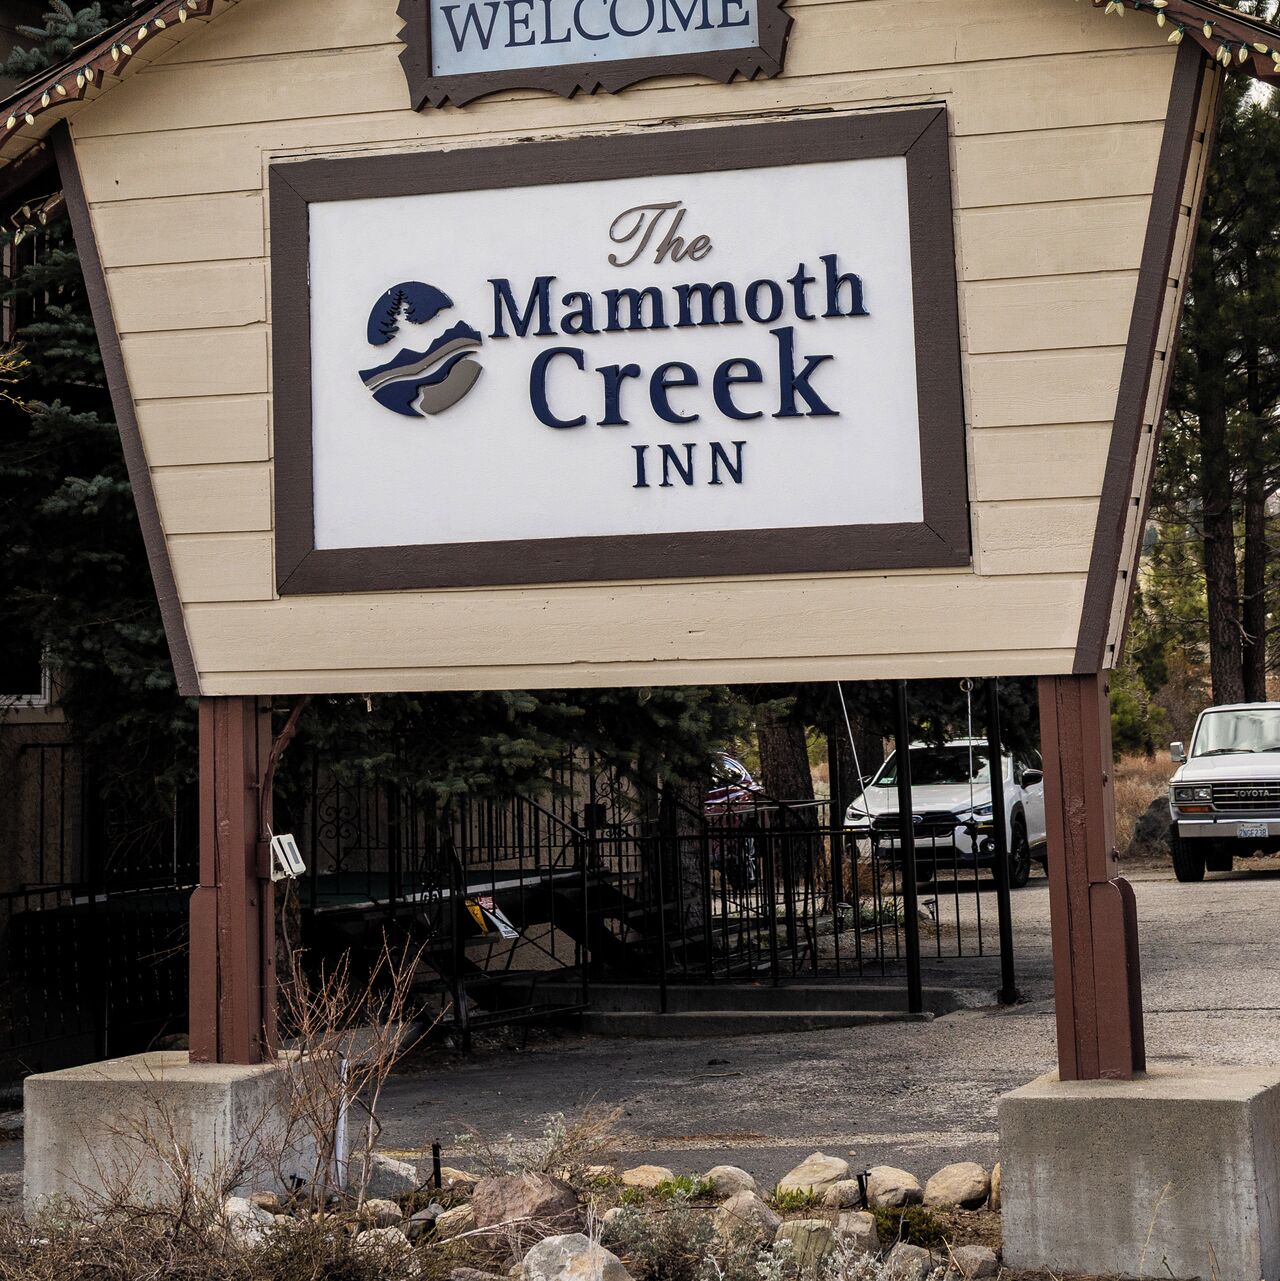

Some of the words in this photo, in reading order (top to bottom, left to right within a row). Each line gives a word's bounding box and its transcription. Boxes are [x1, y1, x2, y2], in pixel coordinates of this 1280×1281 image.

[606, 200, 714, 268] The
[486, 253, 871, 341] Mammoth
[529, 325, 841, 432] Creek
[631, 440, 749, 489] INN
[1234, 789, 1271, 797] TOYOTA
